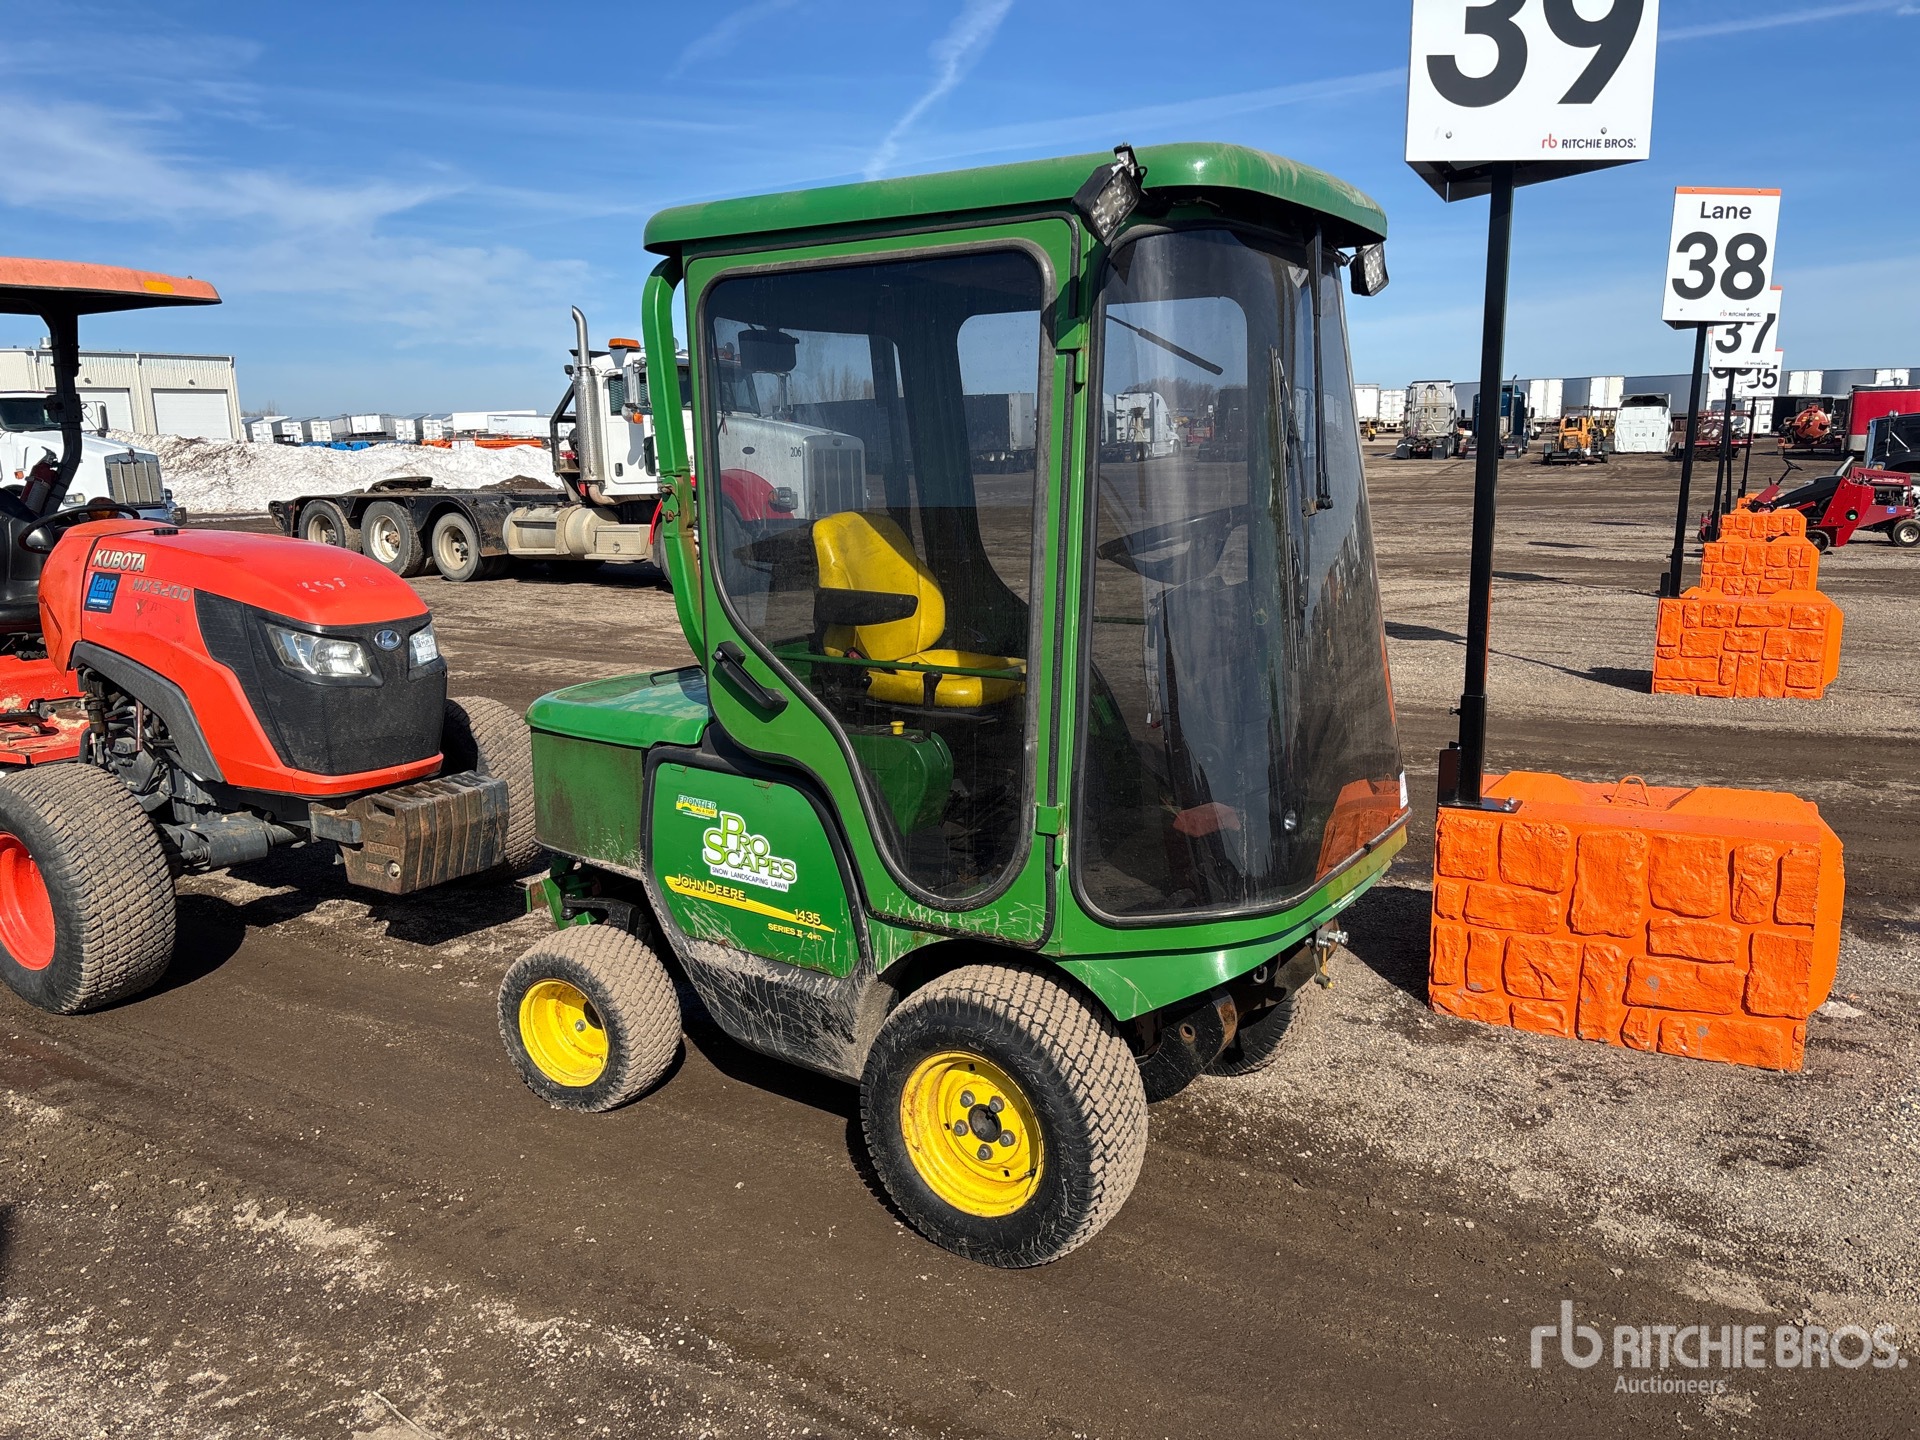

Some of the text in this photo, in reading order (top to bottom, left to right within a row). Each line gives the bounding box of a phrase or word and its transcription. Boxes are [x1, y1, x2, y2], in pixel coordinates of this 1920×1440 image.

[1426, 0, 1646, 108] 39
[1561, 138, 1603, 149] RITCHIE
[1700, 200, 1752, 221] Lane
[1672, 231, 1768, 301] 38
[1715, 313, 1777, 354] 37
[790, 447, 801, 457] 206
[92, 549, 147, 572] KUBOTA
[678, 795, 717, 809] FRONTIER
[675, 873, 746, 902] JOHN DEERE
[711, 866, 788, 890] SNOW LANDSCAPING LAWN
[794, 909, 821, 925] 1435
[768, 922, 796, 937] SERIES
